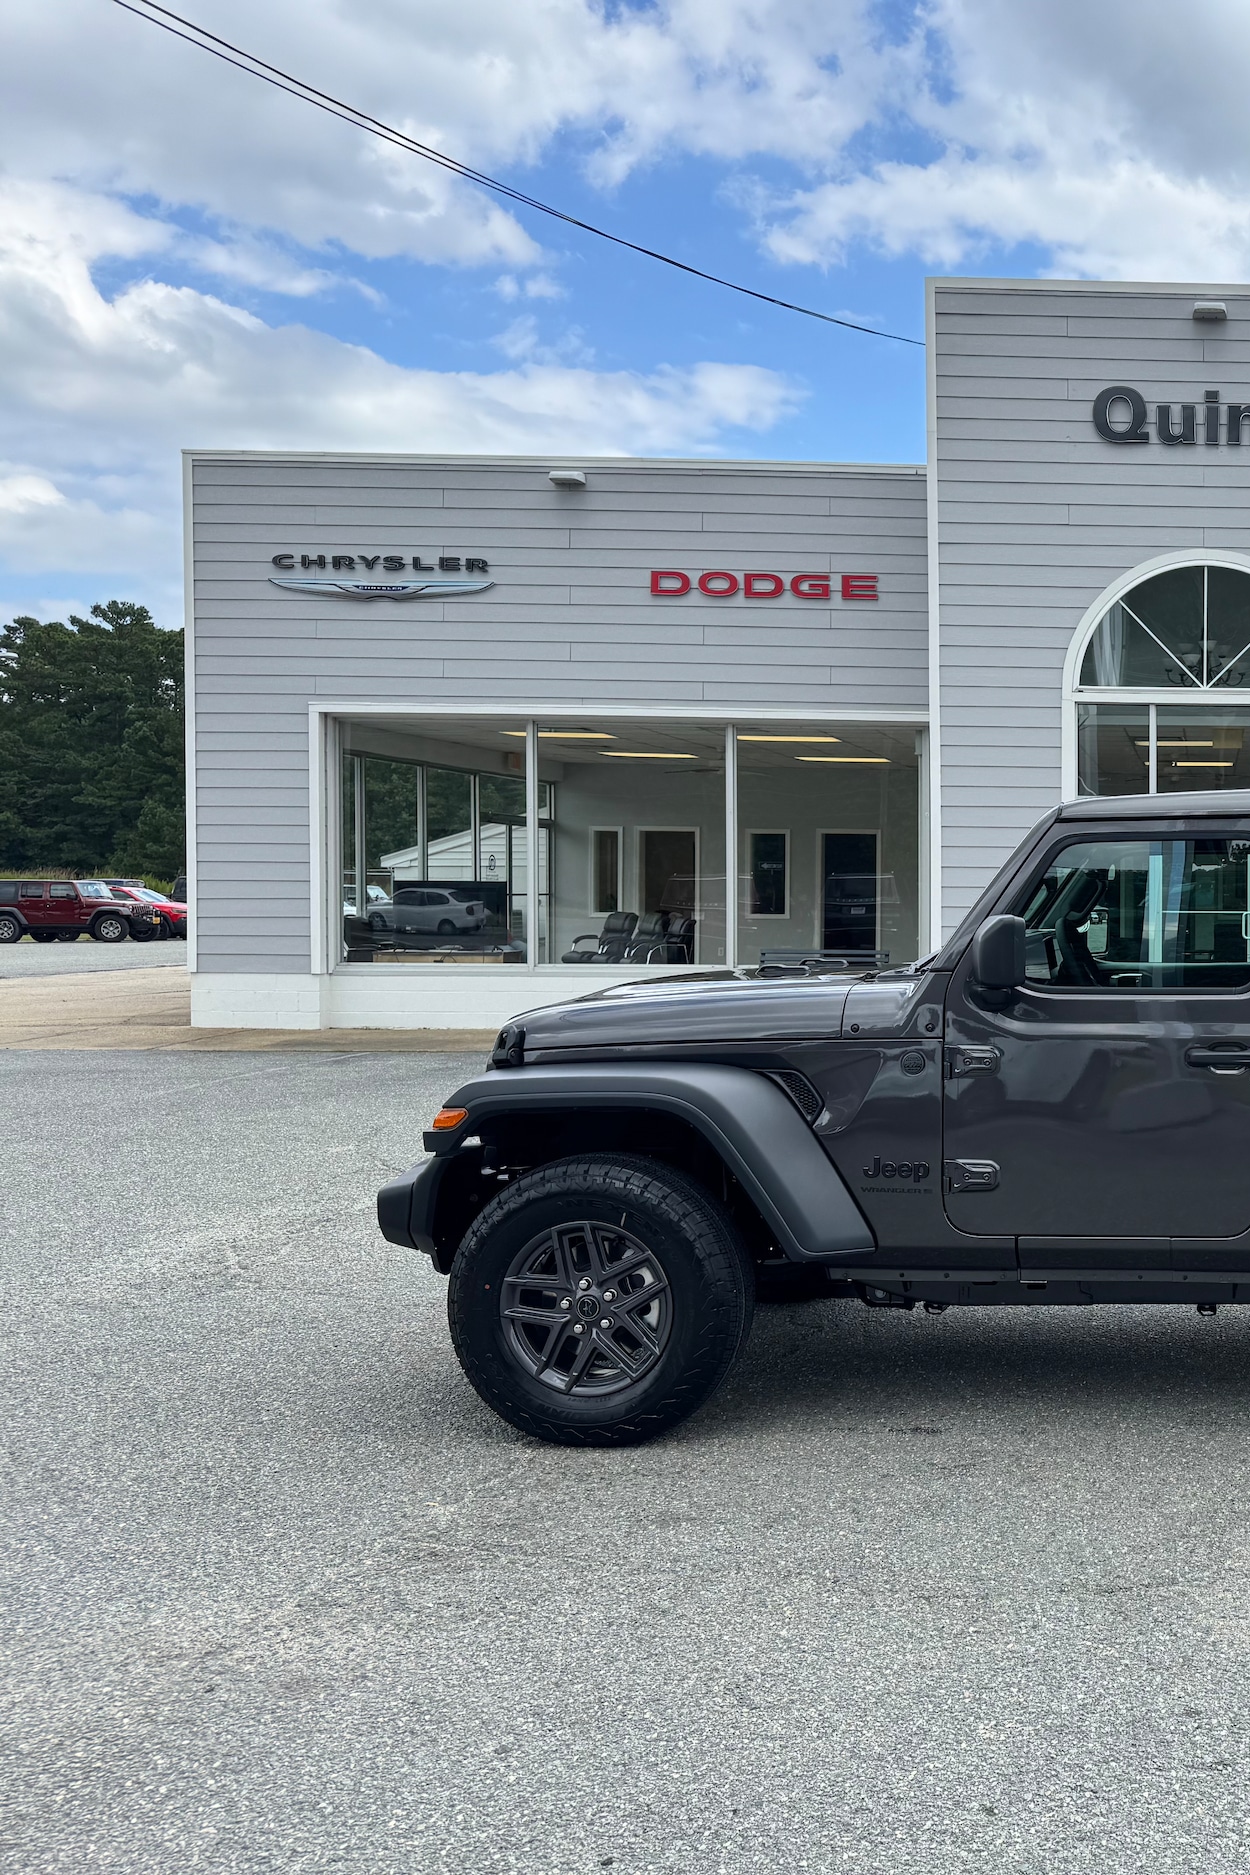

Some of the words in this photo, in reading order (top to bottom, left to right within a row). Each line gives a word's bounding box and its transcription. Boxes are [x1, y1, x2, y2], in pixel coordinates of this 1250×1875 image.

[271, 553, 489, 573] CHRYSLER
[650, 570, 879, 601] DODGE
[862, 1154, 930, 1184] Jeep
[860, 1186, 922, 1196] WRANGLER
